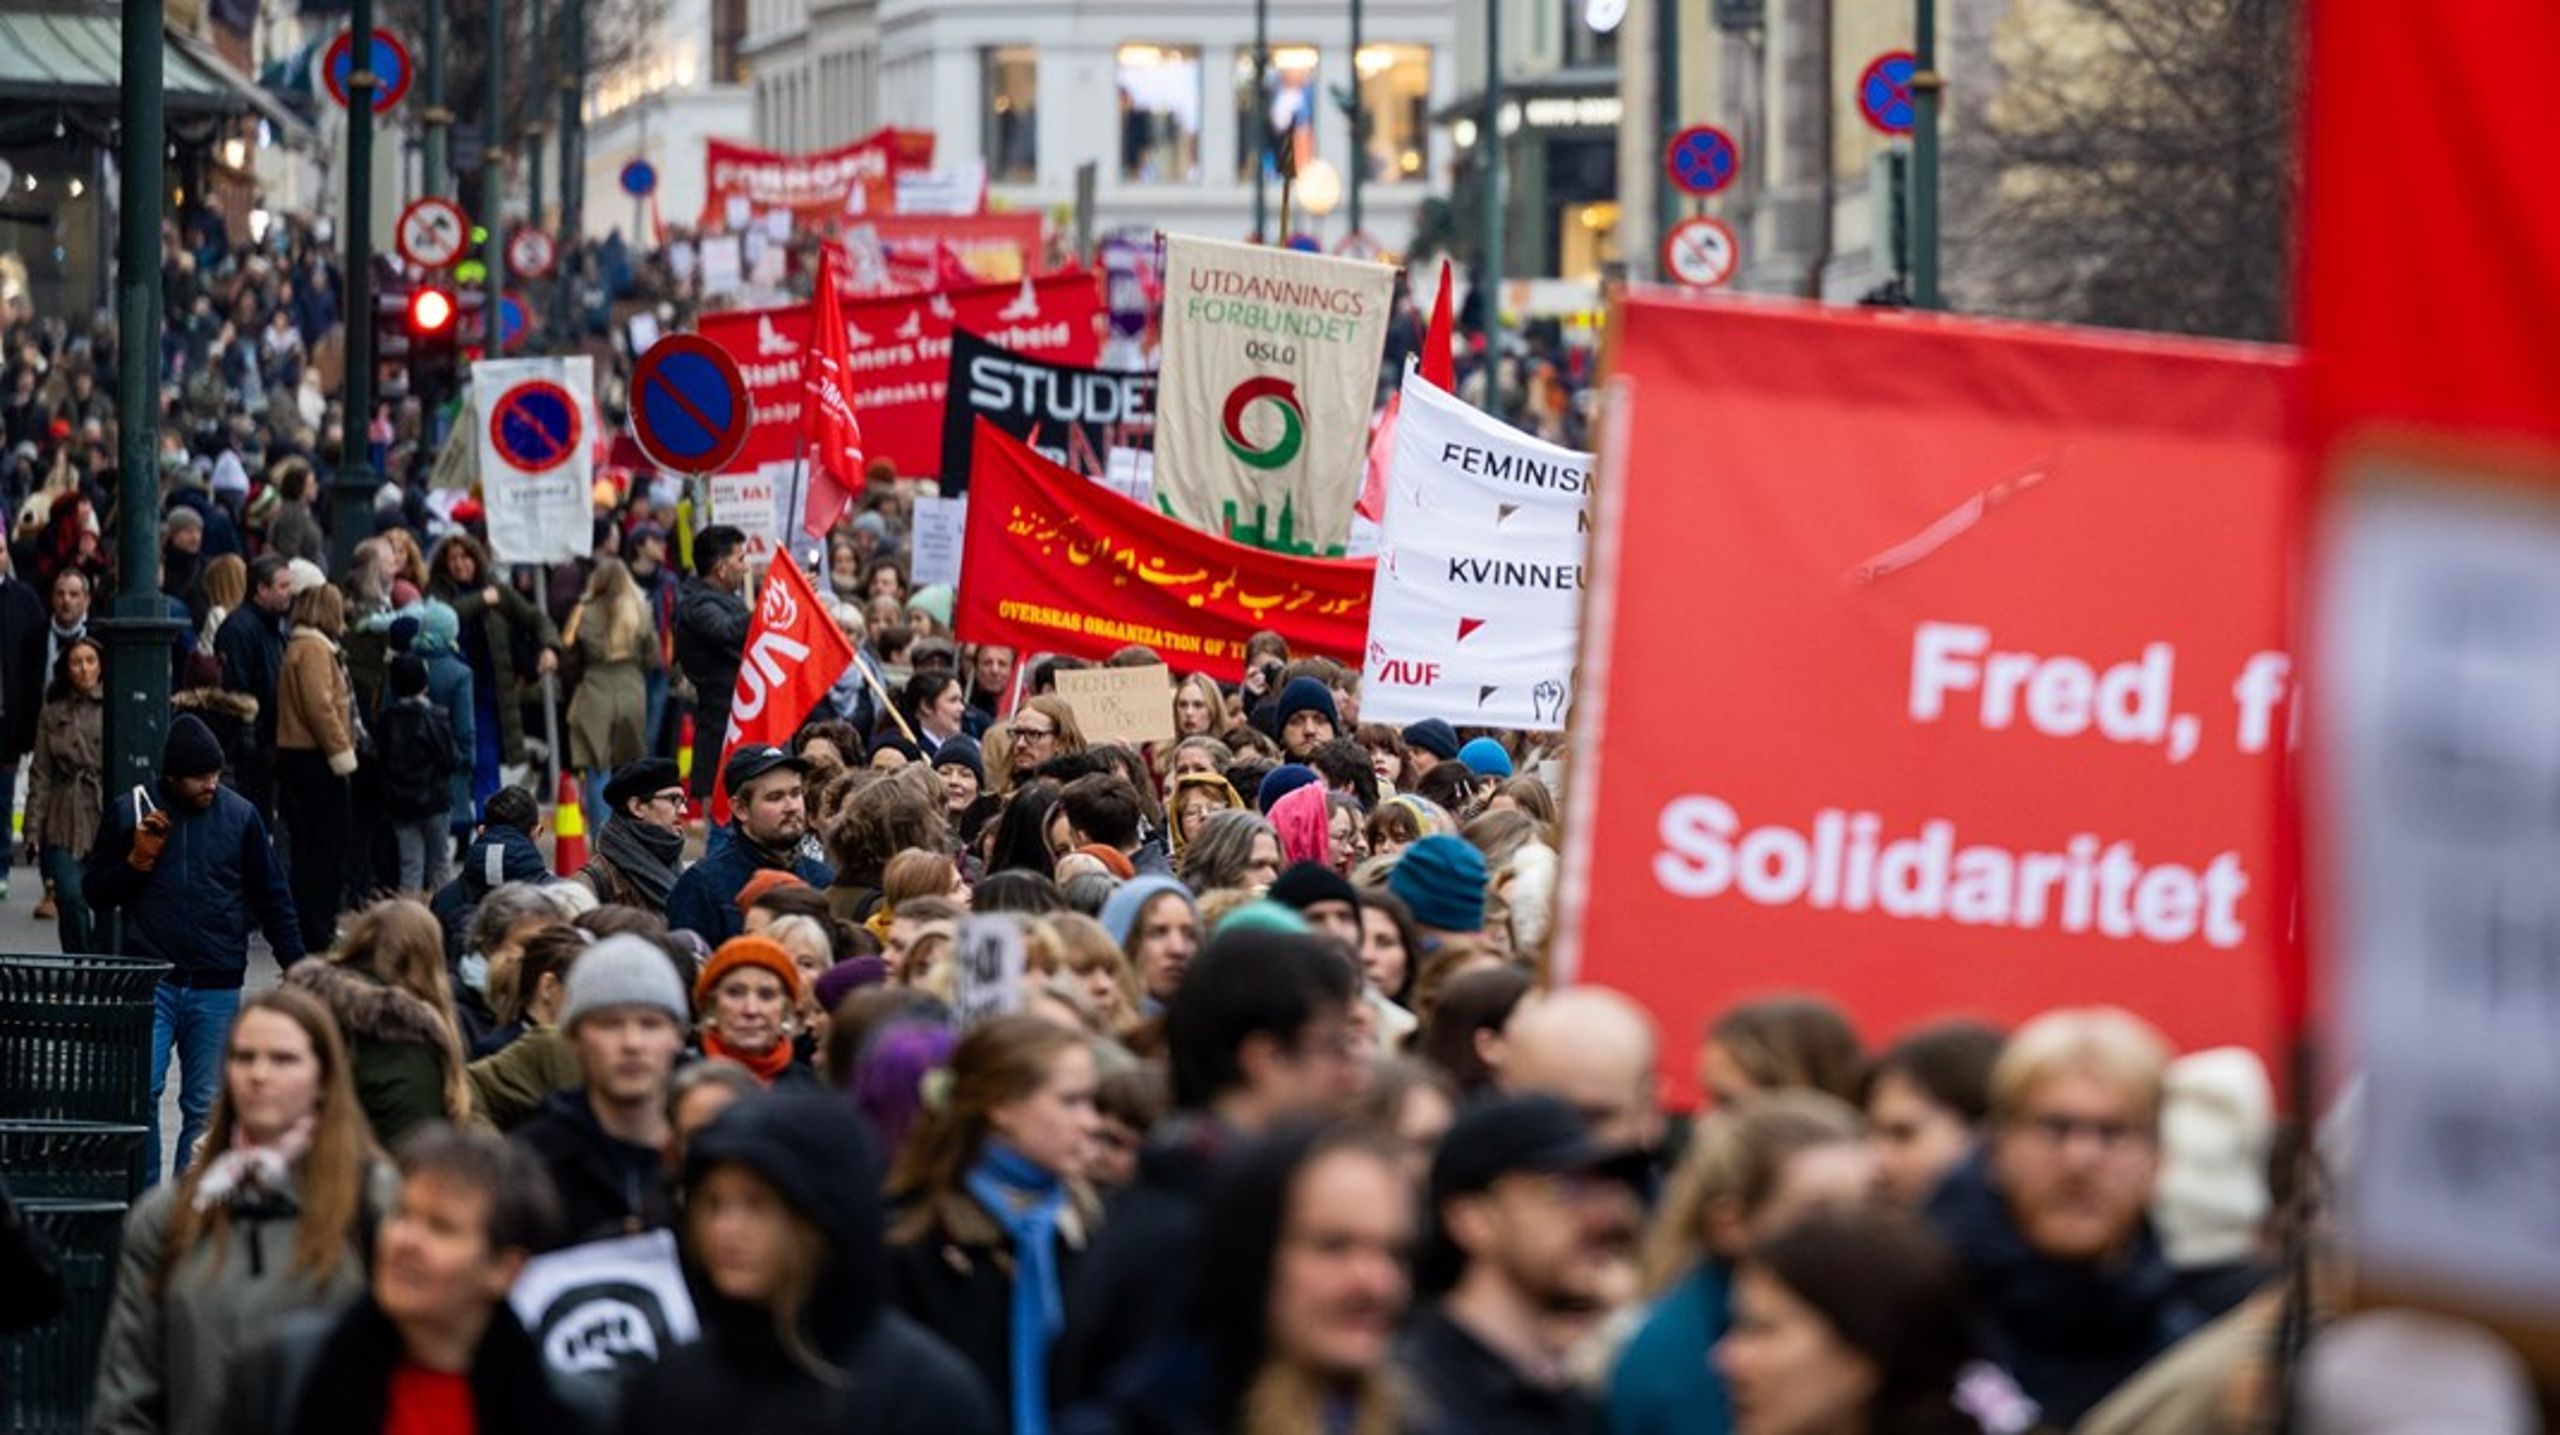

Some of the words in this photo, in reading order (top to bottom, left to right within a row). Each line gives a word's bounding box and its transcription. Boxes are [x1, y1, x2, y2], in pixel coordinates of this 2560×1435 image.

[1190, 267, 1363, 316] UTDANNINGS
[1188, 297, 1359, 344] FORBUNDET
[1245, 339, 1296, 365] OSLO
[999, 600, 1082, 633] OVERSEAS
[1084, 615, 1202, 653] ORGANIZATION
[1204, 638, 1226, 657] OF
[722, 631, 811, 746] AU
[1379, 659, 1441, 686] AUF
[1907, 620, 2201, 765] Fred,
[1653, 793, 2248, 949] Solidaritet
